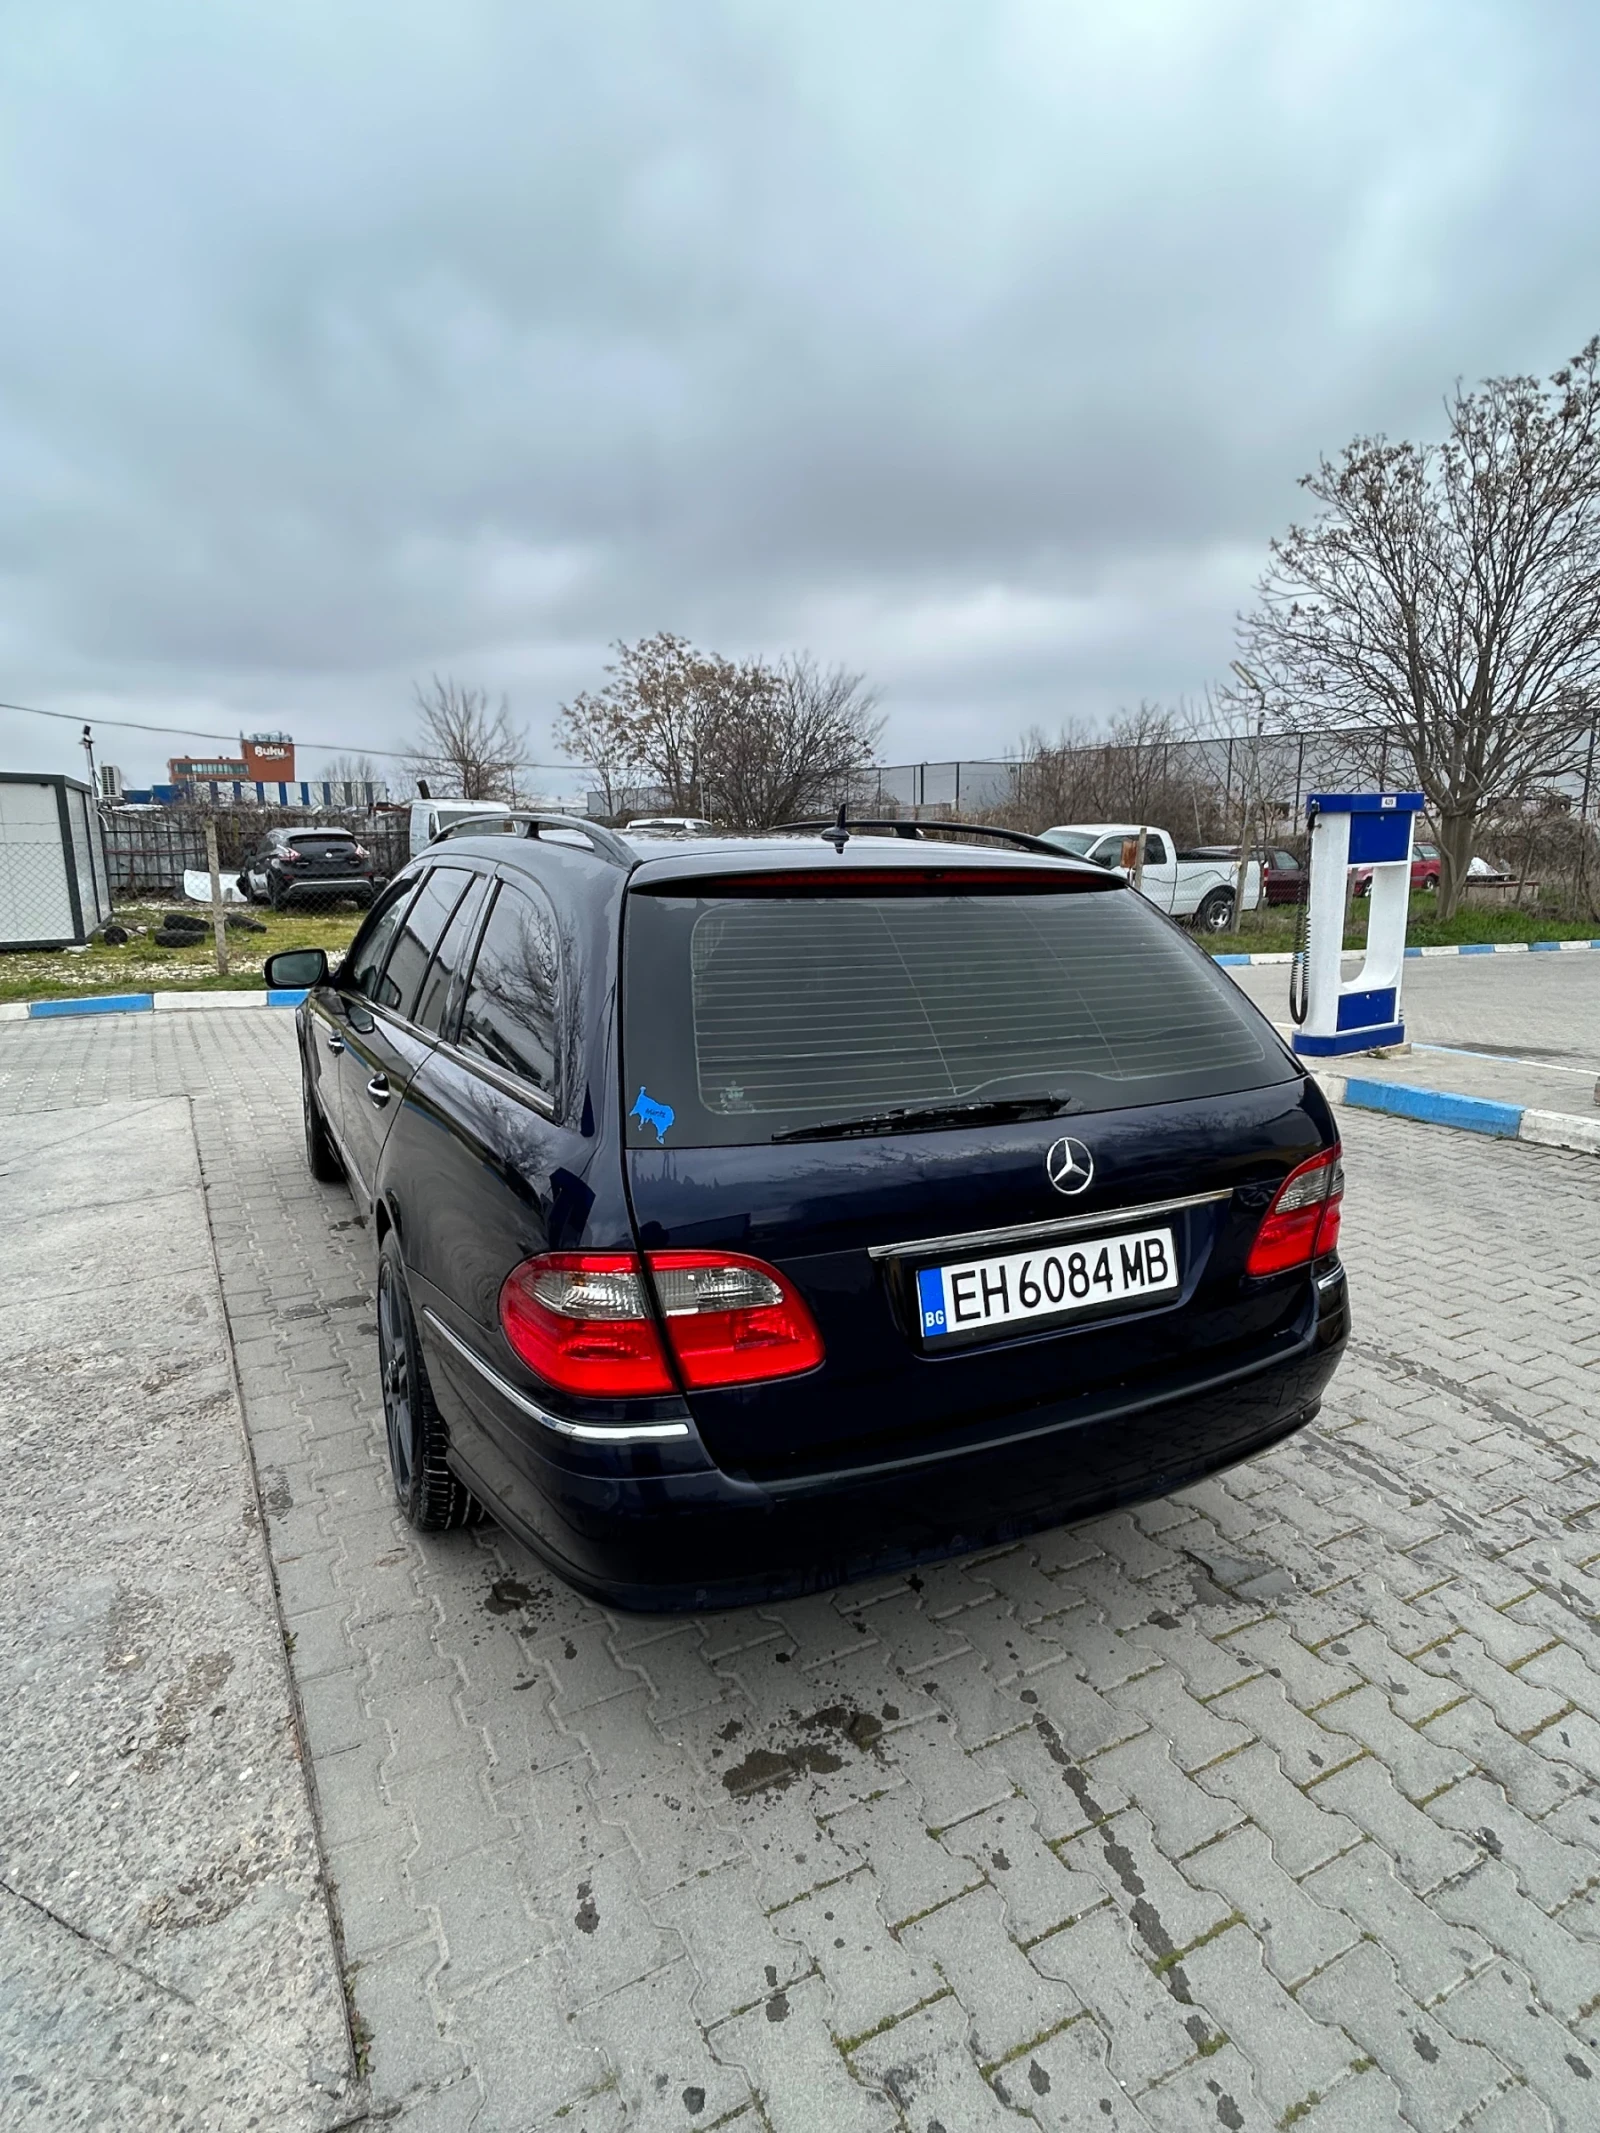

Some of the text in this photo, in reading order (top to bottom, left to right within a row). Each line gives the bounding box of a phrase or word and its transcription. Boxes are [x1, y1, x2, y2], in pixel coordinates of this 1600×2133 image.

[951, 1238, 1168, 1323] EH 6084 MB
[925, 1310, 945, 1328] BG
